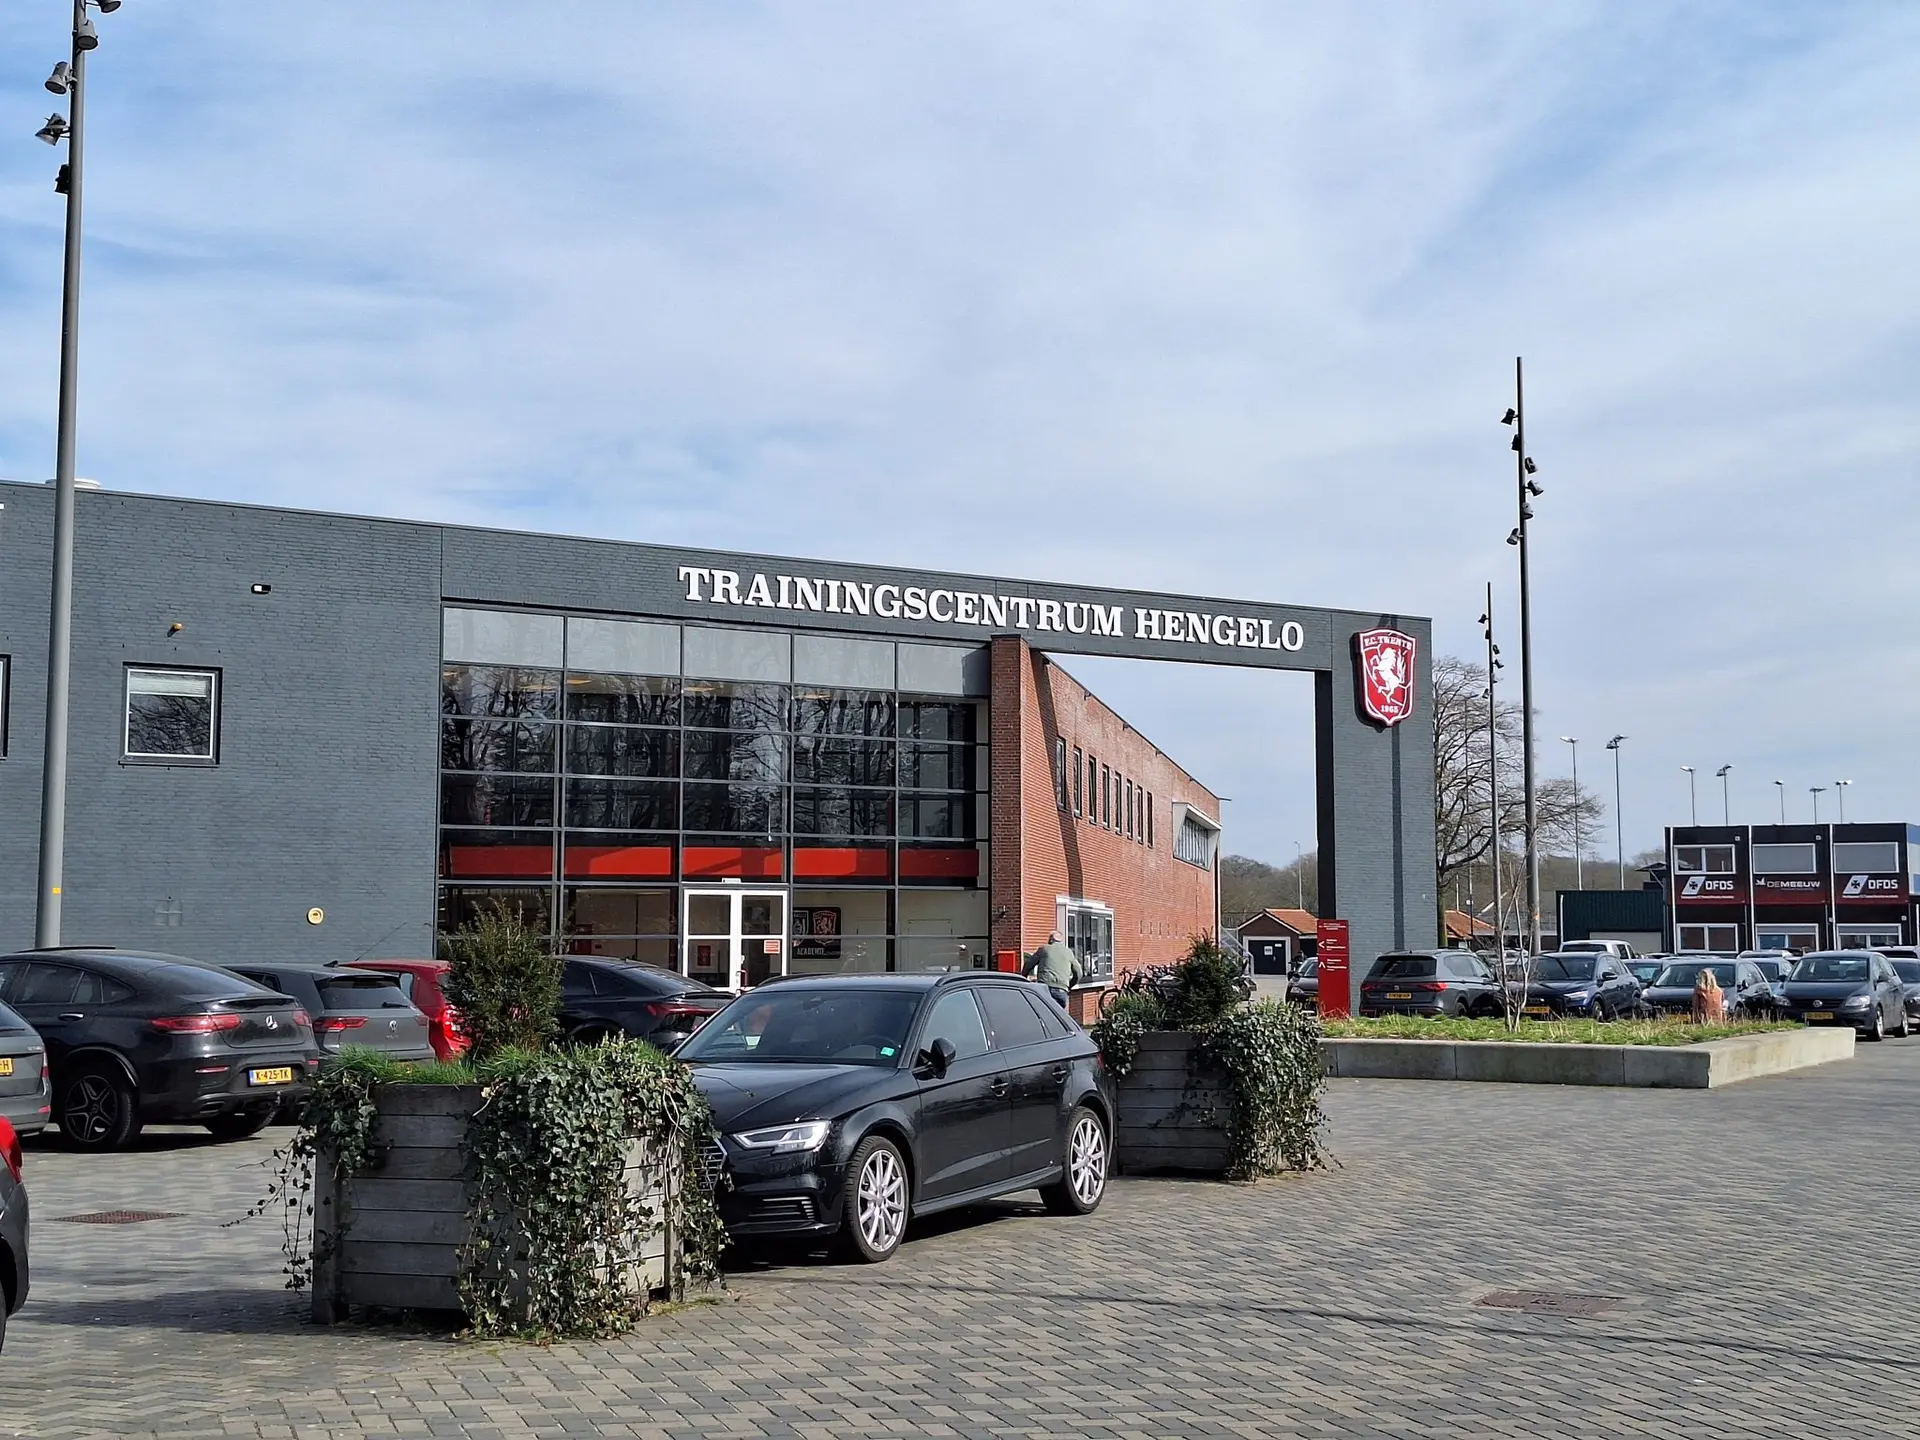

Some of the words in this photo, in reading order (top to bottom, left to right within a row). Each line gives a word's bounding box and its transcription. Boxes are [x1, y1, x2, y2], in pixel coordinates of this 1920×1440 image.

[678, 565, 1124, 638] TRAININGSCENTRUM
[1133, 607, 1305, 652] HENGELO
[1378, 635, 1412, 651] TWENTE
[1705, 880, 1734, 890] DFDS
[1868, 879, 1898, 889] DFDS
